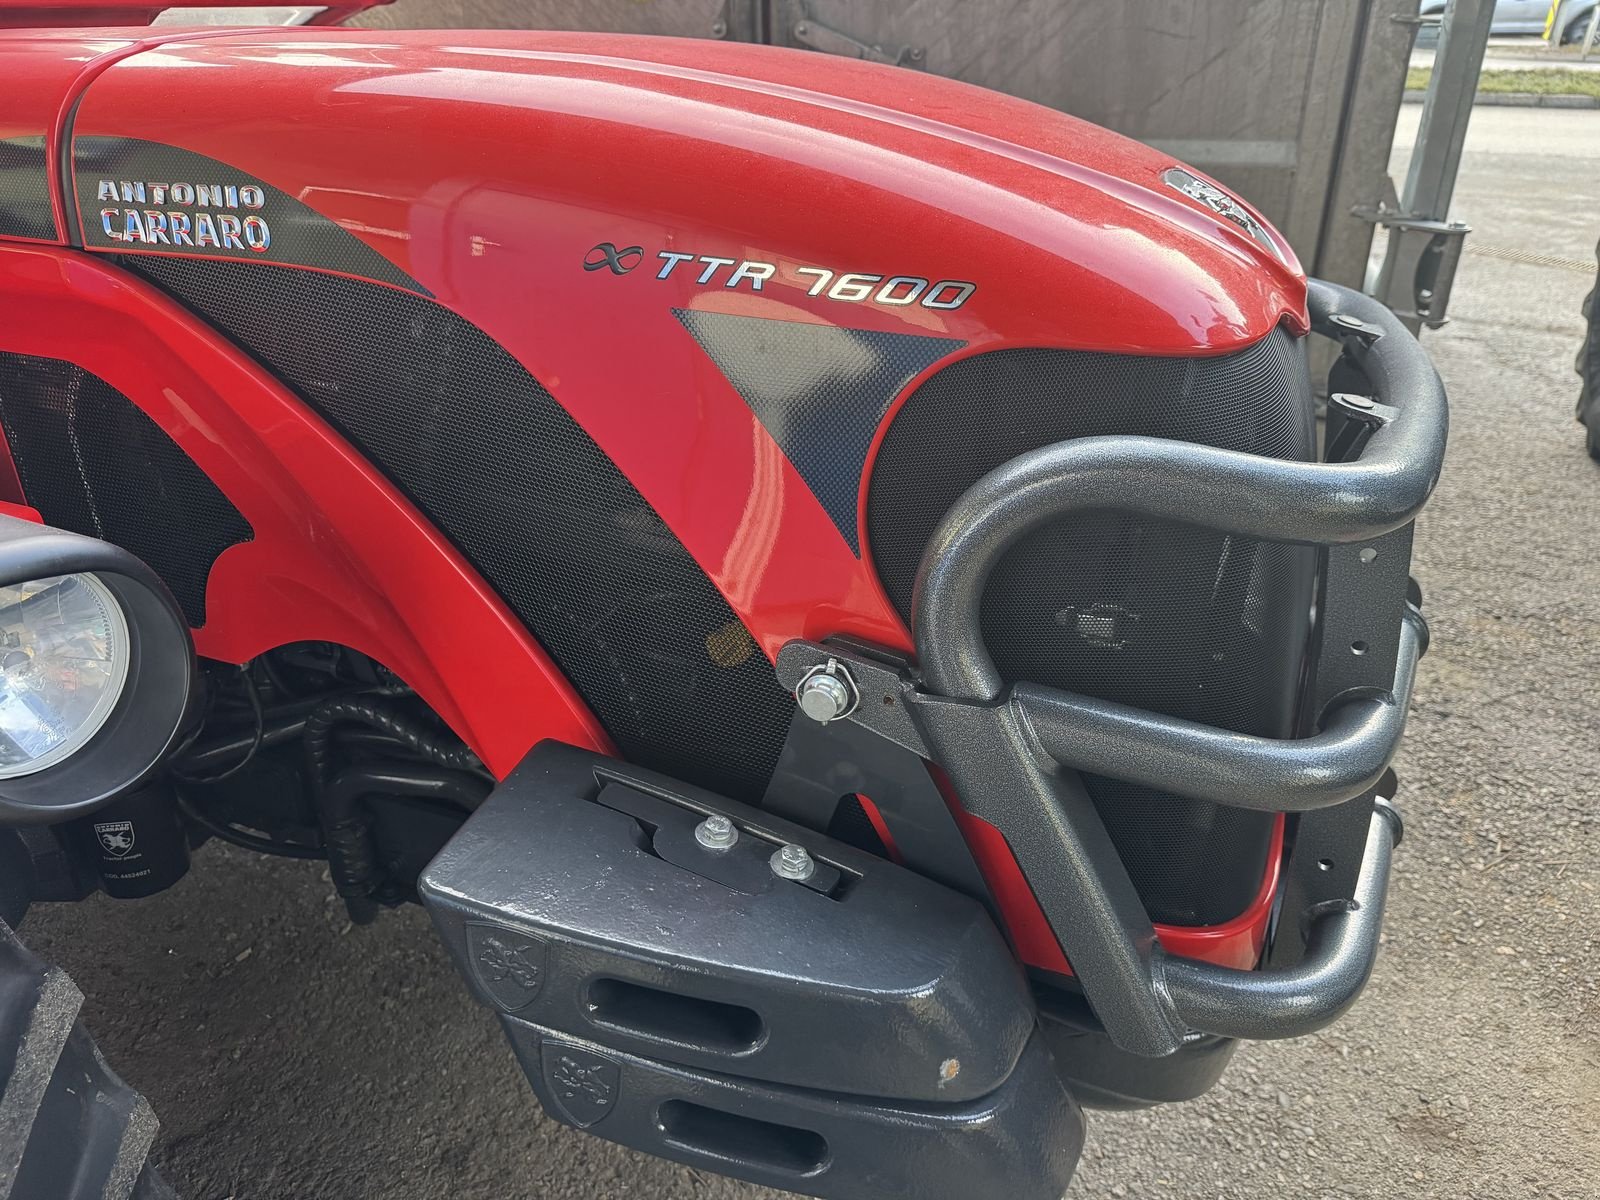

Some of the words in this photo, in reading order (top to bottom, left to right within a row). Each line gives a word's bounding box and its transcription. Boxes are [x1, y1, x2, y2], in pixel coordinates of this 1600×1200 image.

[97, 179, 266, 210] ANTONIO
[100, 207, 272, 253] CARRARO
[656, 250, 777, 291] TTR
[796, 266, 977, 311] 7600
